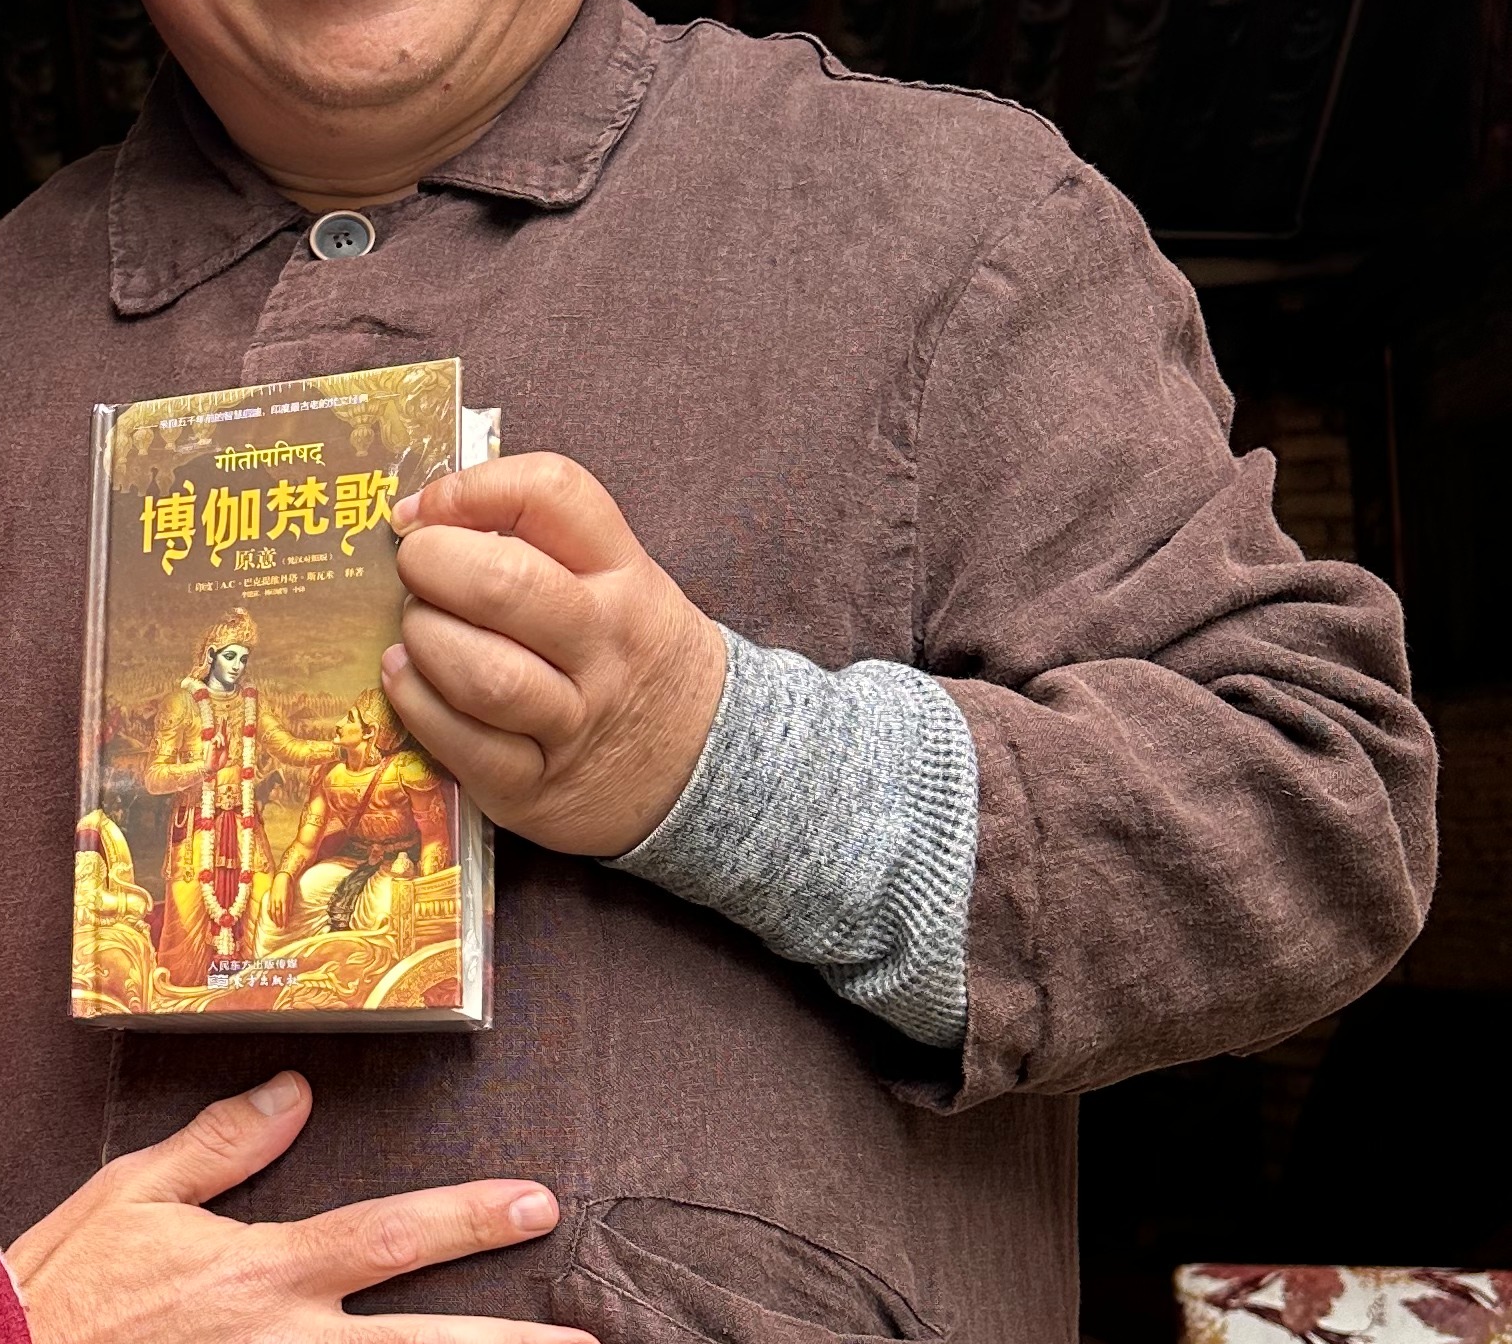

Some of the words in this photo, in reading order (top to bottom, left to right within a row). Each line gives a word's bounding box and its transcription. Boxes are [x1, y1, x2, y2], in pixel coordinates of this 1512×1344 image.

[215, 440, 325, 472] गीतोपनिषद्
[140, 470, 399, 575] 博伽梵歌
[234, 547, 277, 571] 原意
[208, 959, 298, 972] 人民东方出版传媒
[234, 974, 300, 989] 东方出版社
